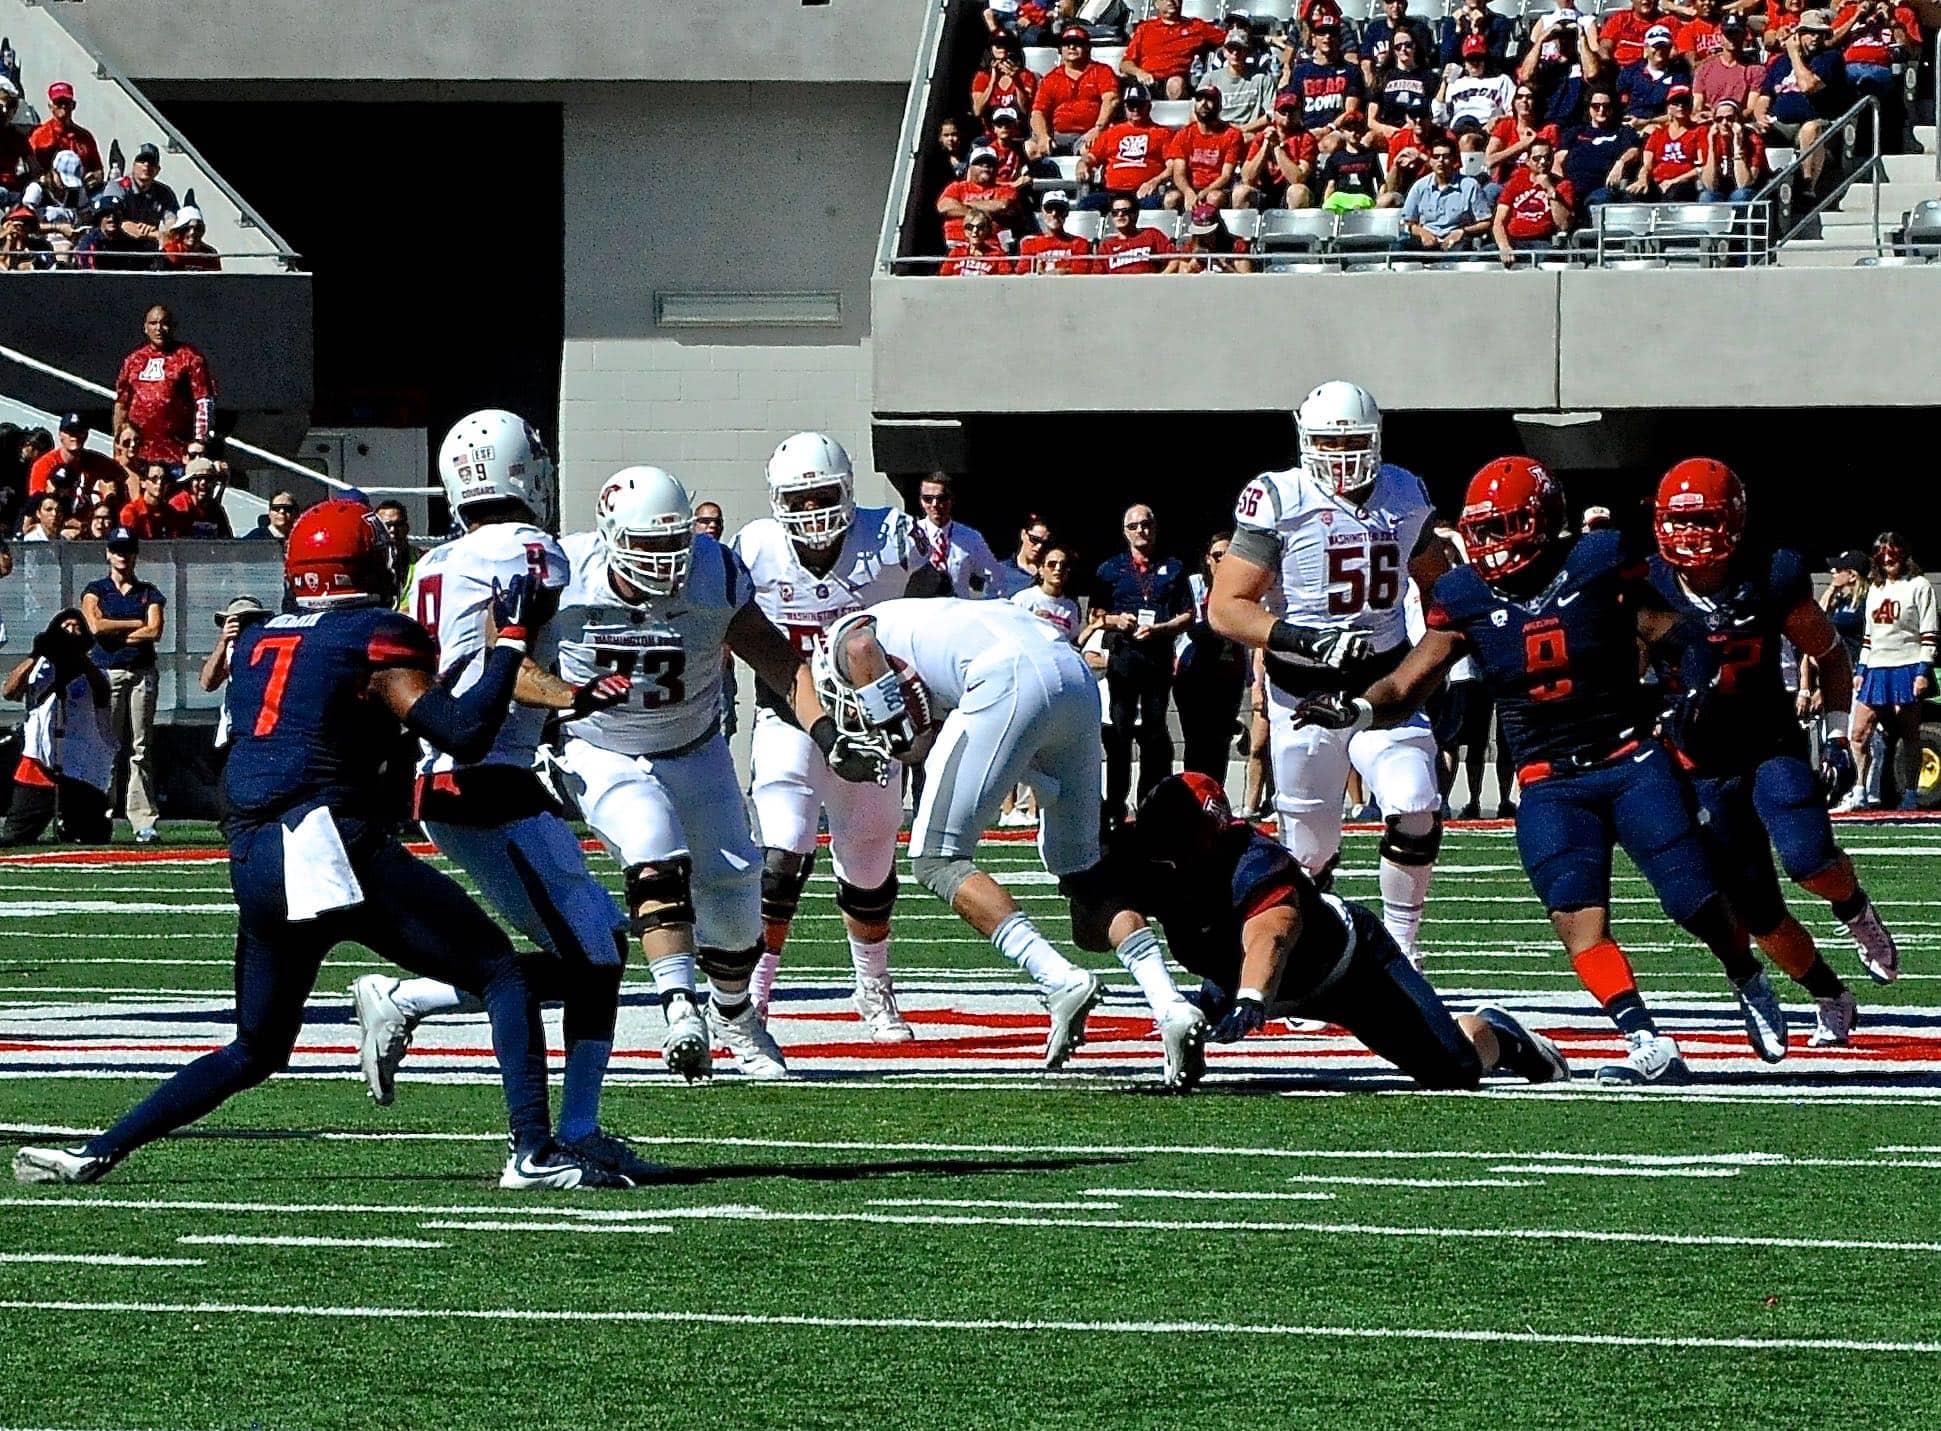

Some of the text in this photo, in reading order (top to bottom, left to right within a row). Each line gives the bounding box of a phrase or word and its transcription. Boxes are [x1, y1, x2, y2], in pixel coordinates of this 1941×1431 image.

[1303, 76, 1346, 96] BEAR
[475, 463, 487, 481] 9
[461, 485, 496, 499] COUGARS
[1328, 532, 1377, 546] WASHINGTON
[1324, 543, 1400, 615] 56
[594, 634, 656, 647] WASHINGTON
[1526, 628, 1573, 702] 9
[250, 634, 303, 737] 7
[594, 649, 686, 709] 73
